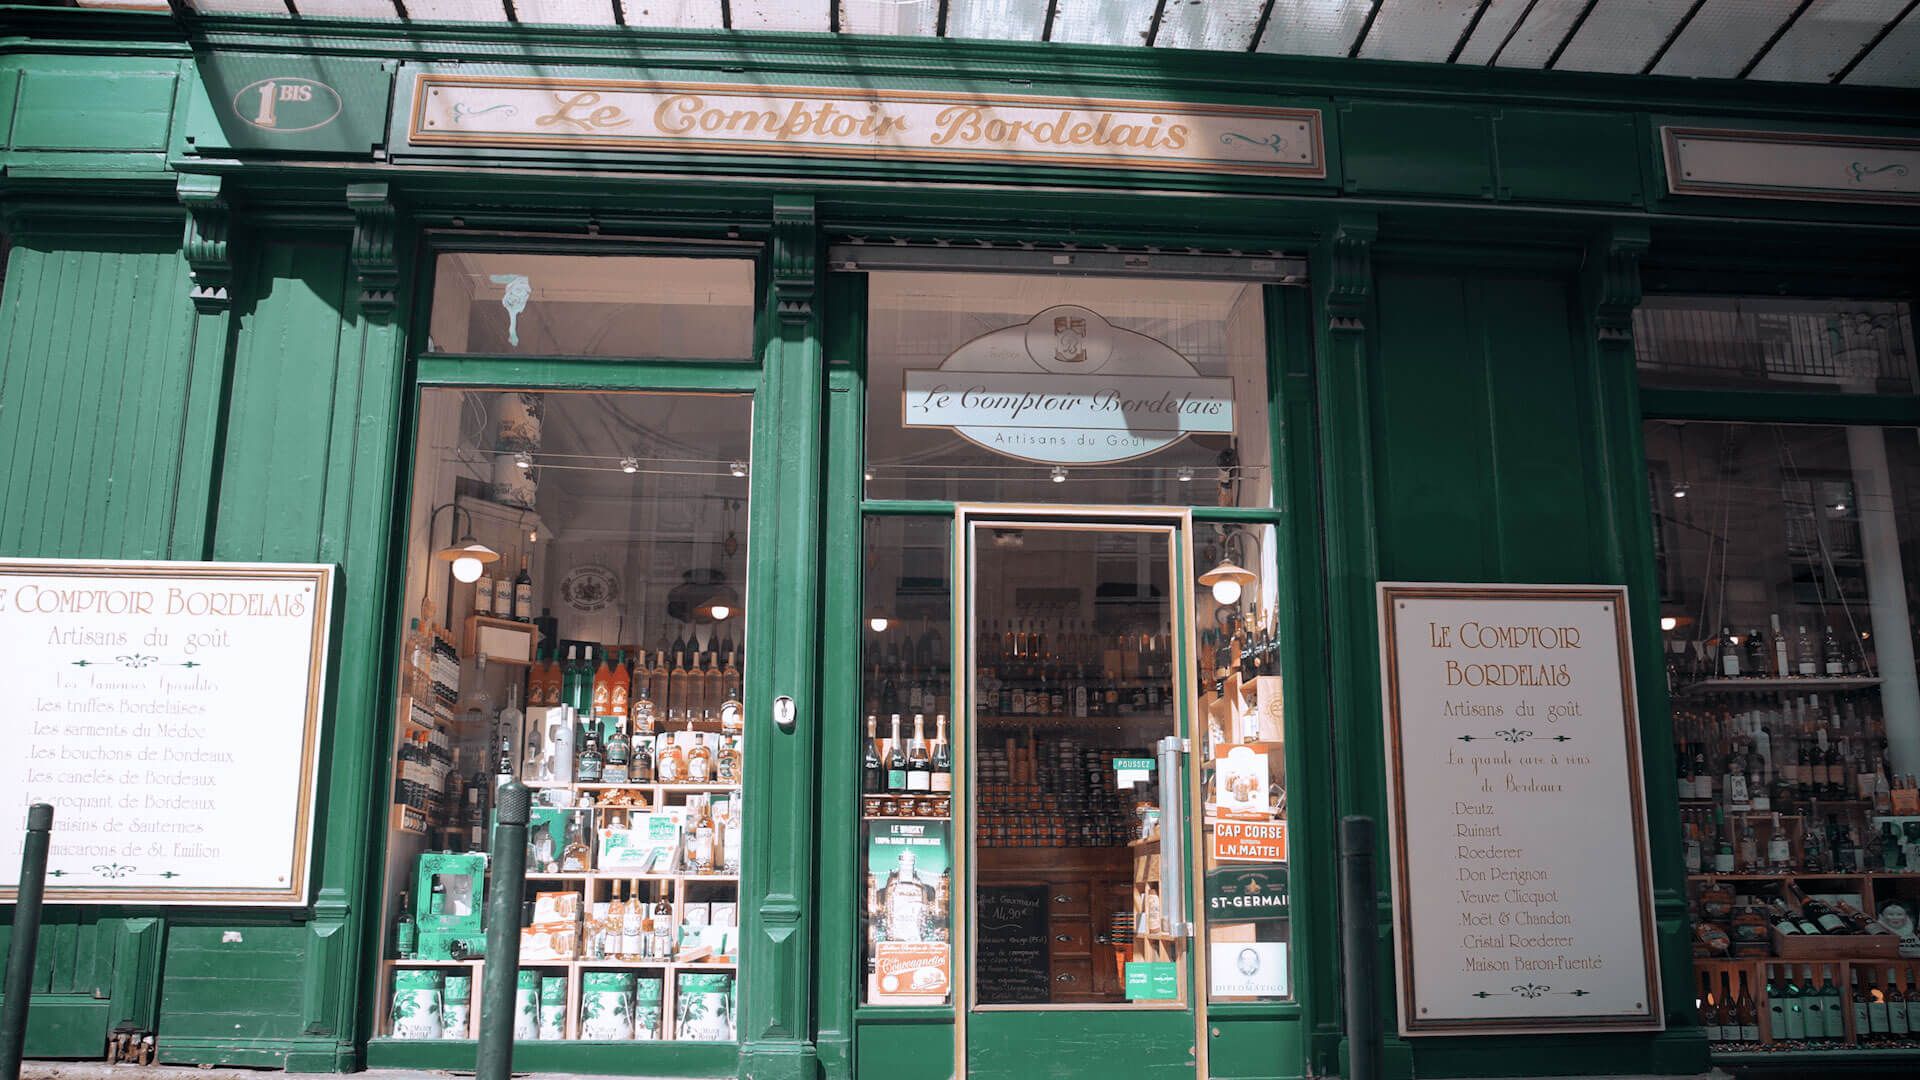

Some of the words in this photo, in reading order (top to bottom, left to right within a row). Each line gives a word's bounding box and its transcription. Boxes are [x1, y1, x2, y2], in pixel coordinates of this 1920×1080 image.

[254, 81, 277, 126] 1
[279, 85, 313, 102] BIS
[535, 92, 630, 131] Le
[653, 94, 907, 140] Comptoir
[930, 105, 1190, 151] Bordelais
[912, 384, 949, 413] Le
[961, 388, 1080, 419] Comptoir
[1089, 387, 1223, 416] Bordelais
[994, 432, 1067, 446] Artisans
[1077, 433, 1096, 446] du
[15, 584, 154, 615] COMPTOIR
[165, 587, 305, 617] BORDELAIS
[47, 625, 128, 646] Artisans
[143, 626, 169, 647] du
[184, 628, 231, 655] goût
[1429, 622, 1451, 649] LE
[1459, 621, 1583, 649] COMPTOIR
[1446, 660, 1571, 687] BORDELAIS
[67, 696, 115, 714] truffes
[119, 699, 208, 715] Bordelaises
[1443, 700, 1504, 717] Artisans
[1515, 700, 1535, 717] du
[1547, 700, 1583, 723] goût
[63, 722, 128, 737] sarments
[132, 722, 151, 737] du
[61, 745, 132, 760] bouchons
[138, 746, 158, 761] de
[163, 747, 234, 763] Bordeaux
[1118, 760, 1150, 769] POUSSEZ
[57, 768, 114, 784] canelés
[119, 769, 140, 784] de
[145, 770, 217, 786] Bordeaux
[118, 793, 140, 808] de
[144, 794, 216, 810] Bordeaux
[103, 817, 124, 832] de
[129, 817, 205, 833] Sauternes
[1217, 824, 1240, 837] CAP
[1245, 825, 1282, 839] CORSE
[121, 841, 143, 857] de
[174, 842, 220, 858] Emilion
[1211, 895, 1290, 908] ST-GERMAI
[1504, 888, 1559, 907] Clicquot
[1498, 912, 1510, 926] &
[1515, 911, 1571, 925] Chandon
[1509, 934, 1574, 948] Roederer
